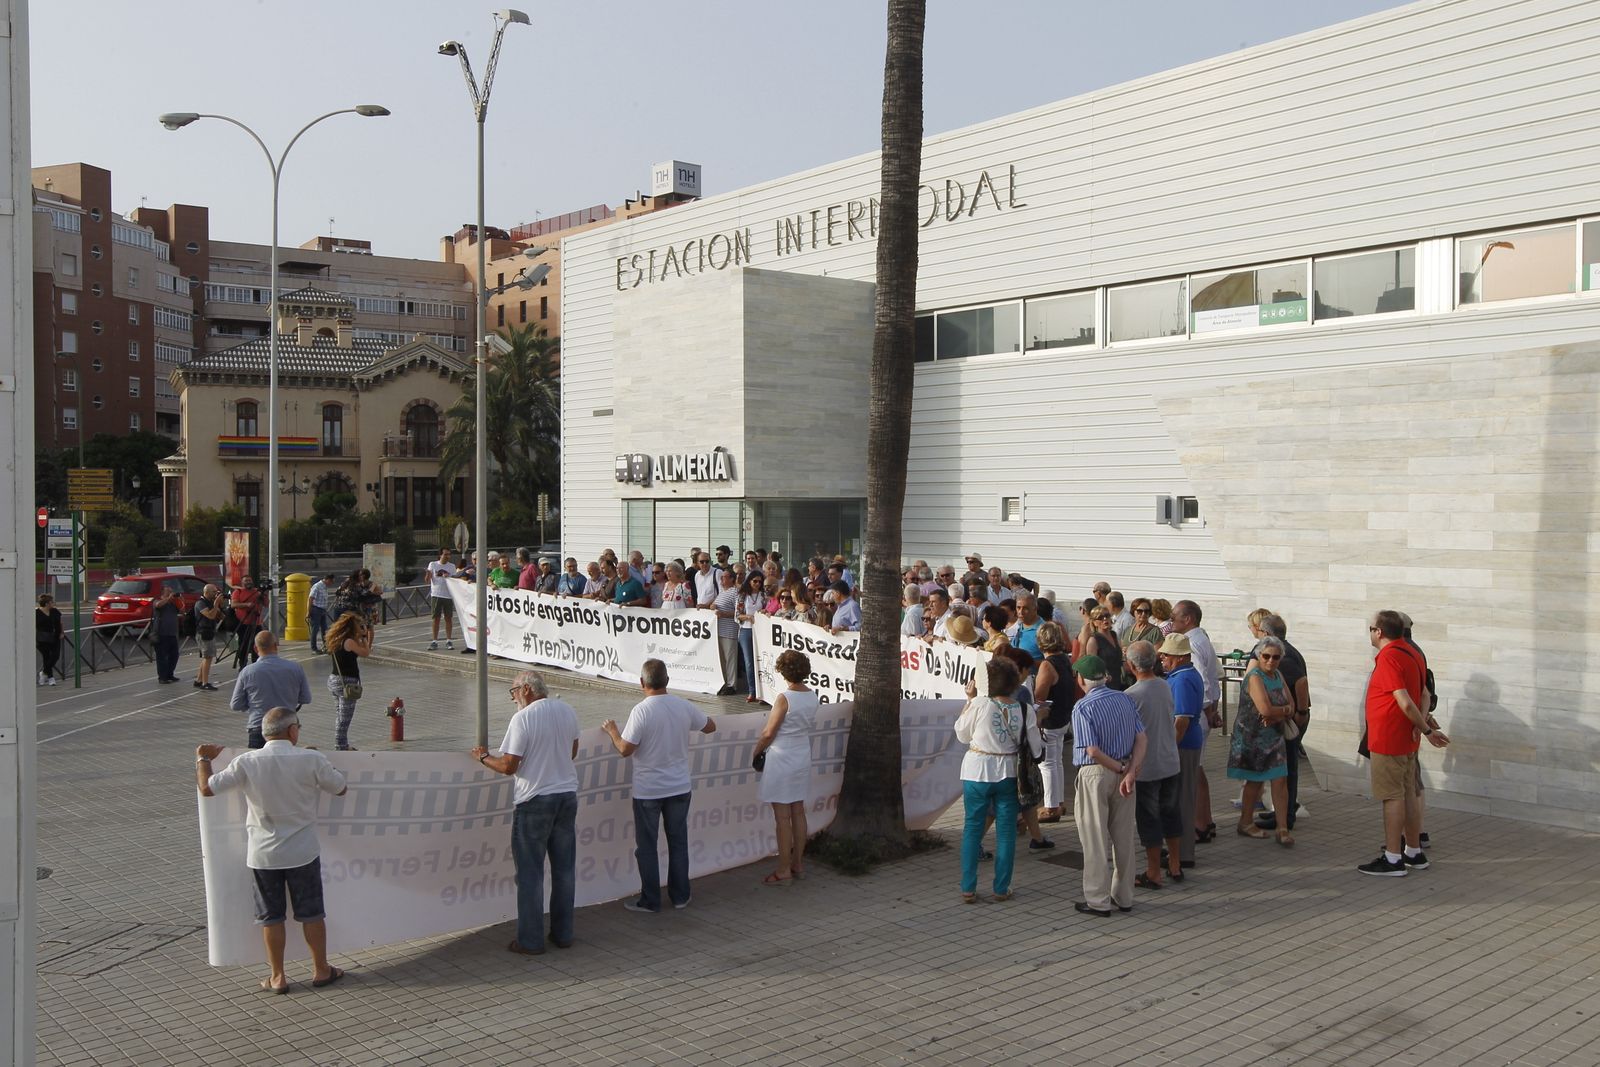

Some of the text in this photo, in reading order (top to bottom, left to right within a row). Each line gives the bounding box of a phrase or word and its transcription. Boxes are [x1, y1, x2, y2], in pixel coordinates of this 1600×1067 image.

[652, 445, 730, 482] ALMERÍA
[523, 595, 536, 618] de
[537, 601, 600, 627] engaños
[613, 613, 712, 641] promesas
[771, 624, 860, 661] Buscand
